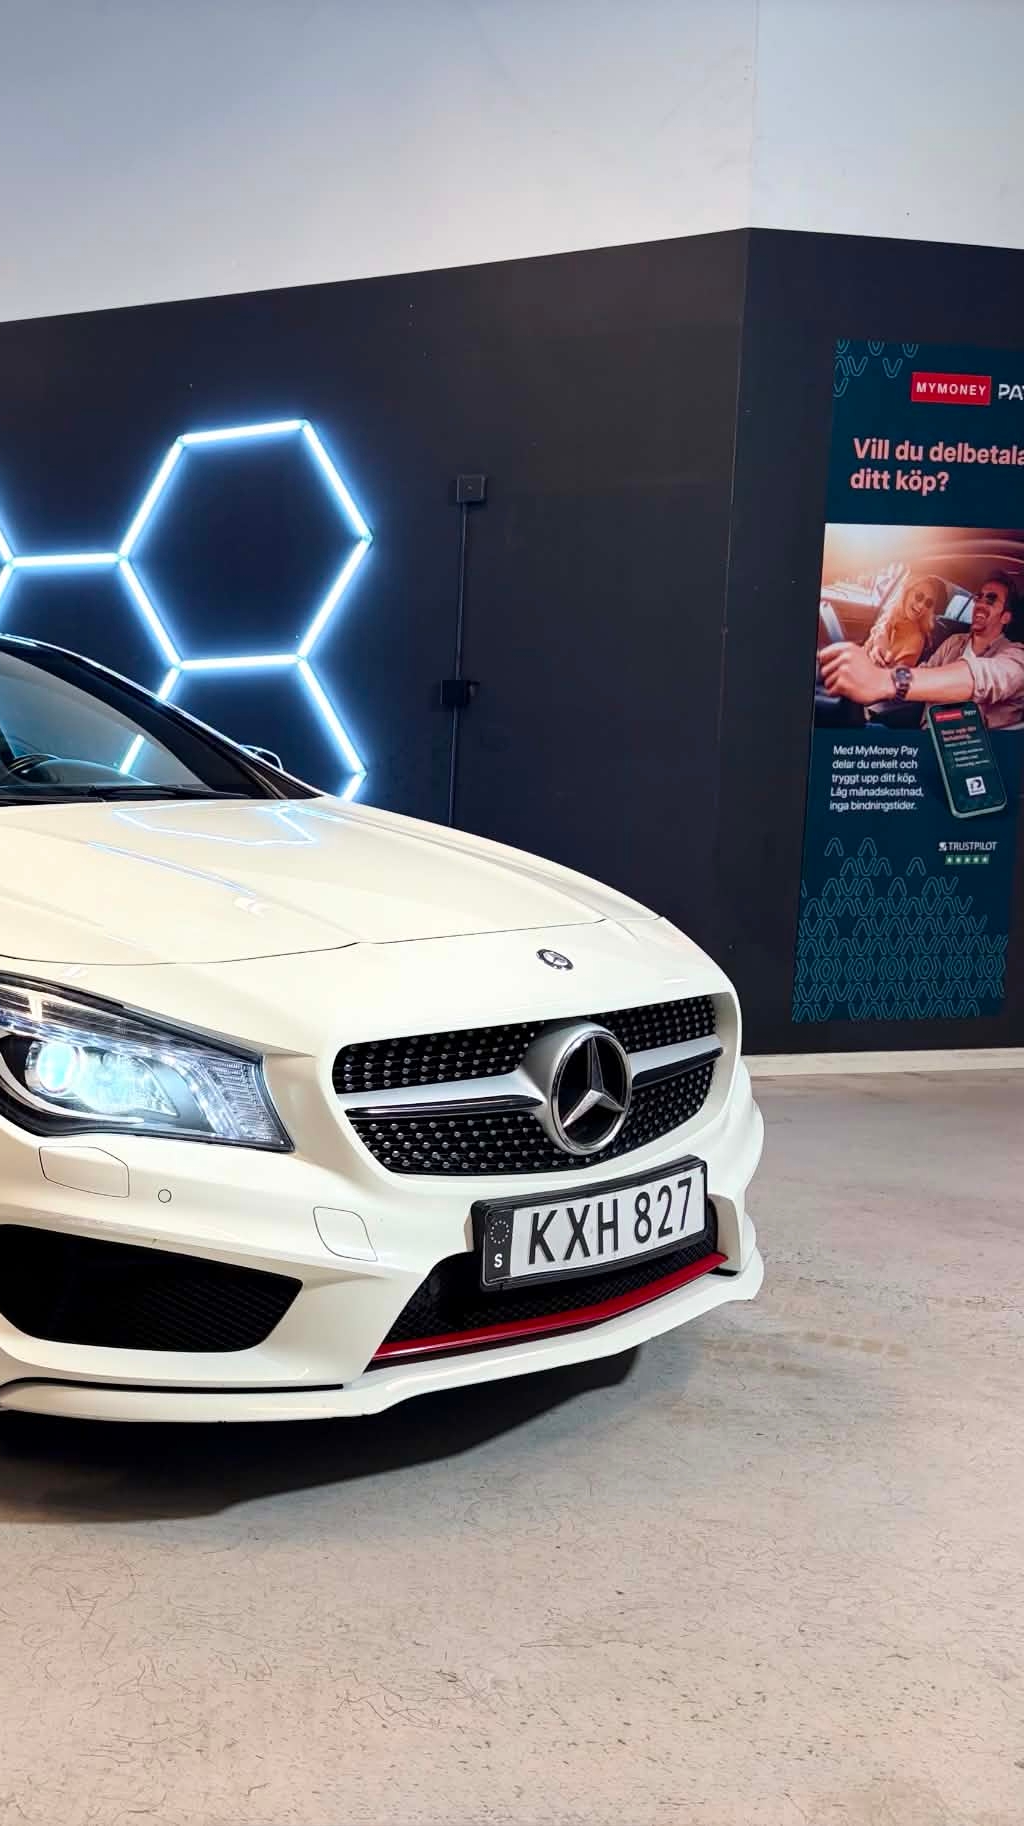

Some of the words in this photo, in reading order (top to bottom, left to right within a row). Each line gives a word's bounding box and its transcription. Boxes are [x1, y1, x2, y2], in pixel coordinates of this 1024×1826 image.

[916, 382, 987, 396] MYMONEY
[998, 383, 1024, 400] PA
[853, 437, 890, 460] Vill
[895, 440, 924, 461] du
[929, 441, 1024, 466] delbetala
[850, 468, 890, 490] ditt
[895, 470, 949, 497] köp?
[833, 745, 854, 756] Med
[854, 745, 899, 757] MyMoney
[900, 745, 919, 758] Pay
[832, 759, 856, 769] delar
[856, 759, 870, 769] du
[870, 759, 898, 769] enkelt
[899, 759, 918, 769] och
[831, 773, 859, 784] tryggt
[861, 774, 879, 785] upp
[880, 772, 896, 783] ditt
[897, 772, 917, 785] köp.
[830, 786, 848, 798] Låg
[848, 786, 925, 798] månadskostnad,
[850, 800, 917, 812] bindningstider.
[947, 841, 998, 851] TRUSTPILOT
[528, 1198, 619, 1265] KXH
[633, 1176, 693, 1244] 827
[493, 1253, 503, 1268] S
